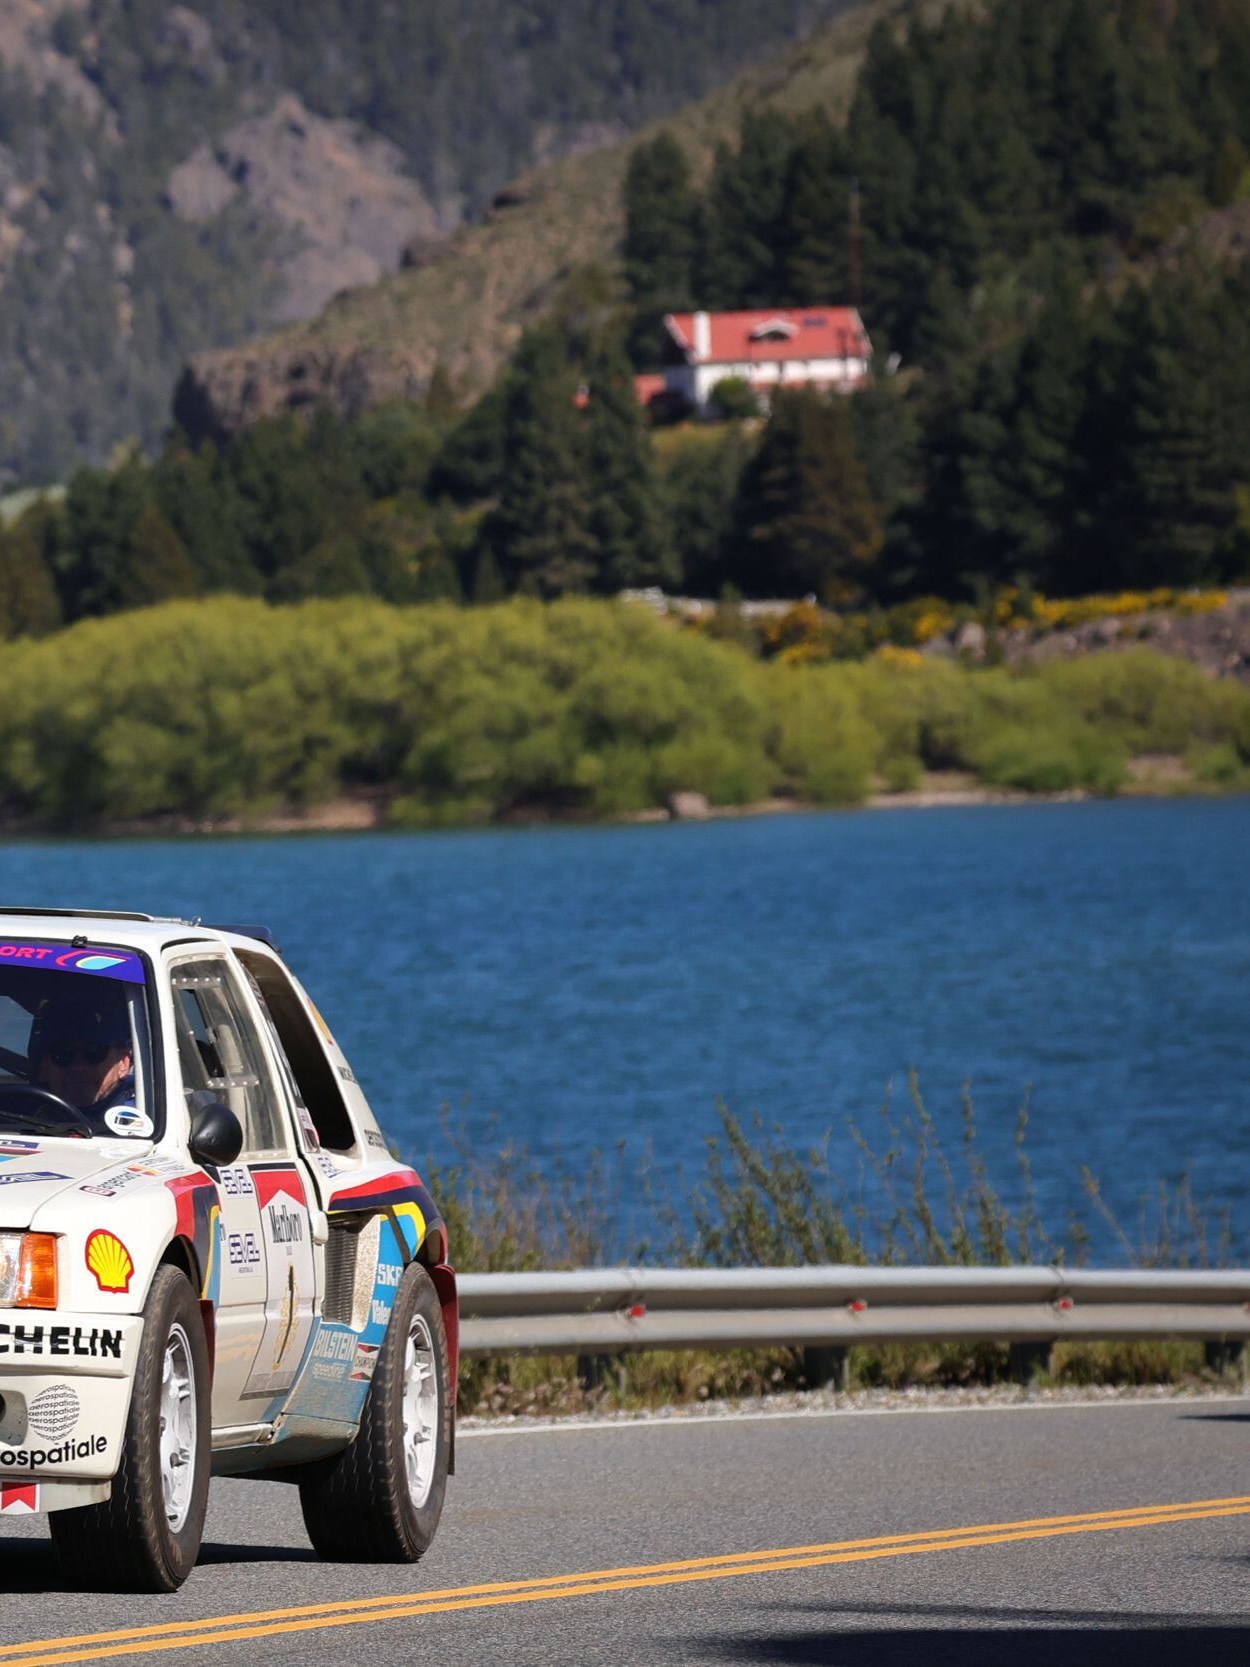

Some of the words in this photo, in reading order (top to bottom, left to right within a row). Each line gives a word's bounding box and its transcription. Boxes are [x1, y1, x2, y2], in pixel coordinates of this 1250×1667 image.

[268, 1205, 303, 1243] Marlboro
[229, 1233, 260, 1264] SEVEL
[312, 1329, 359, 1362] BILSTEIN
